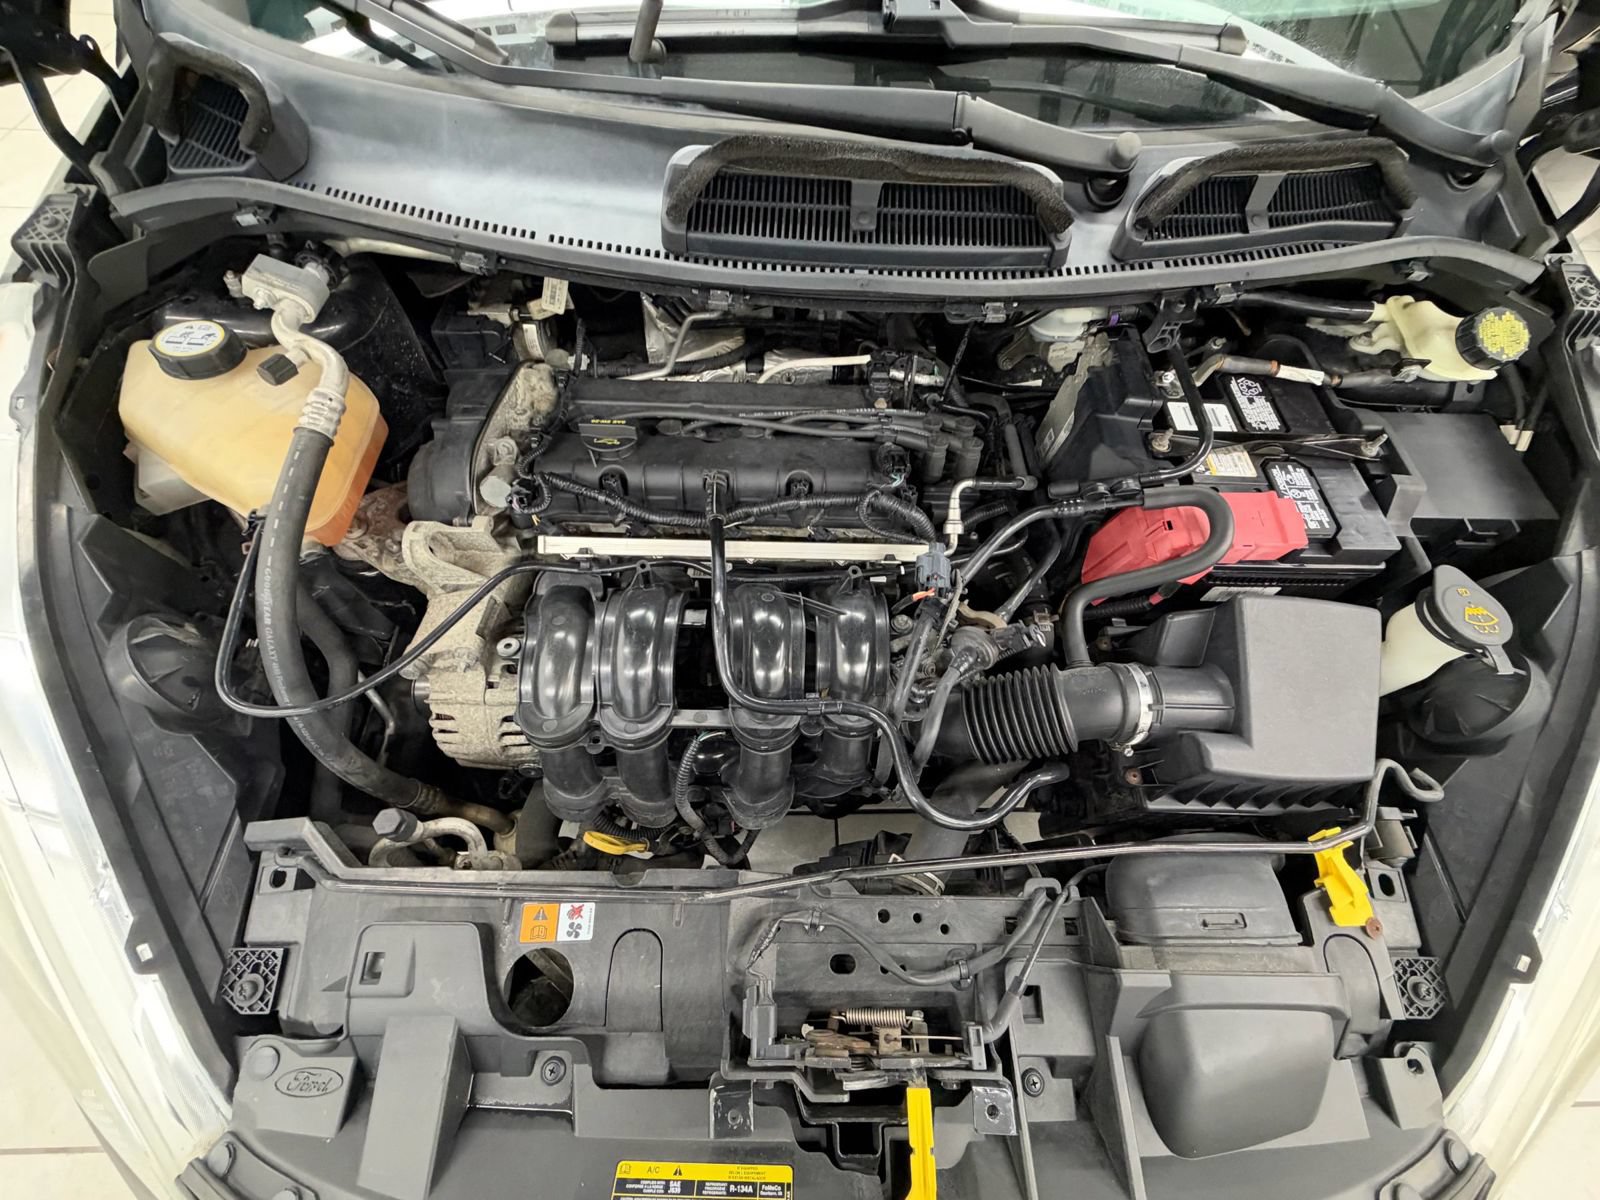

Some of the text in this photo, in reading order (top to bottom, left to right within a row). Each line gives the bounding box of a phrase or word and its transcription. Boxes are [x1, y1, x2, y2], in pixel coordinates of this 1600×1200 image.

[263, 568, 273, 625] GOODYEAR
[265, 627, 279, 661] GALAXY
[286, 1071, 333, 1092] Ford
[646, 1166, 660, 1174] A/C
[729, 1184, 753, 1193] R-134A
